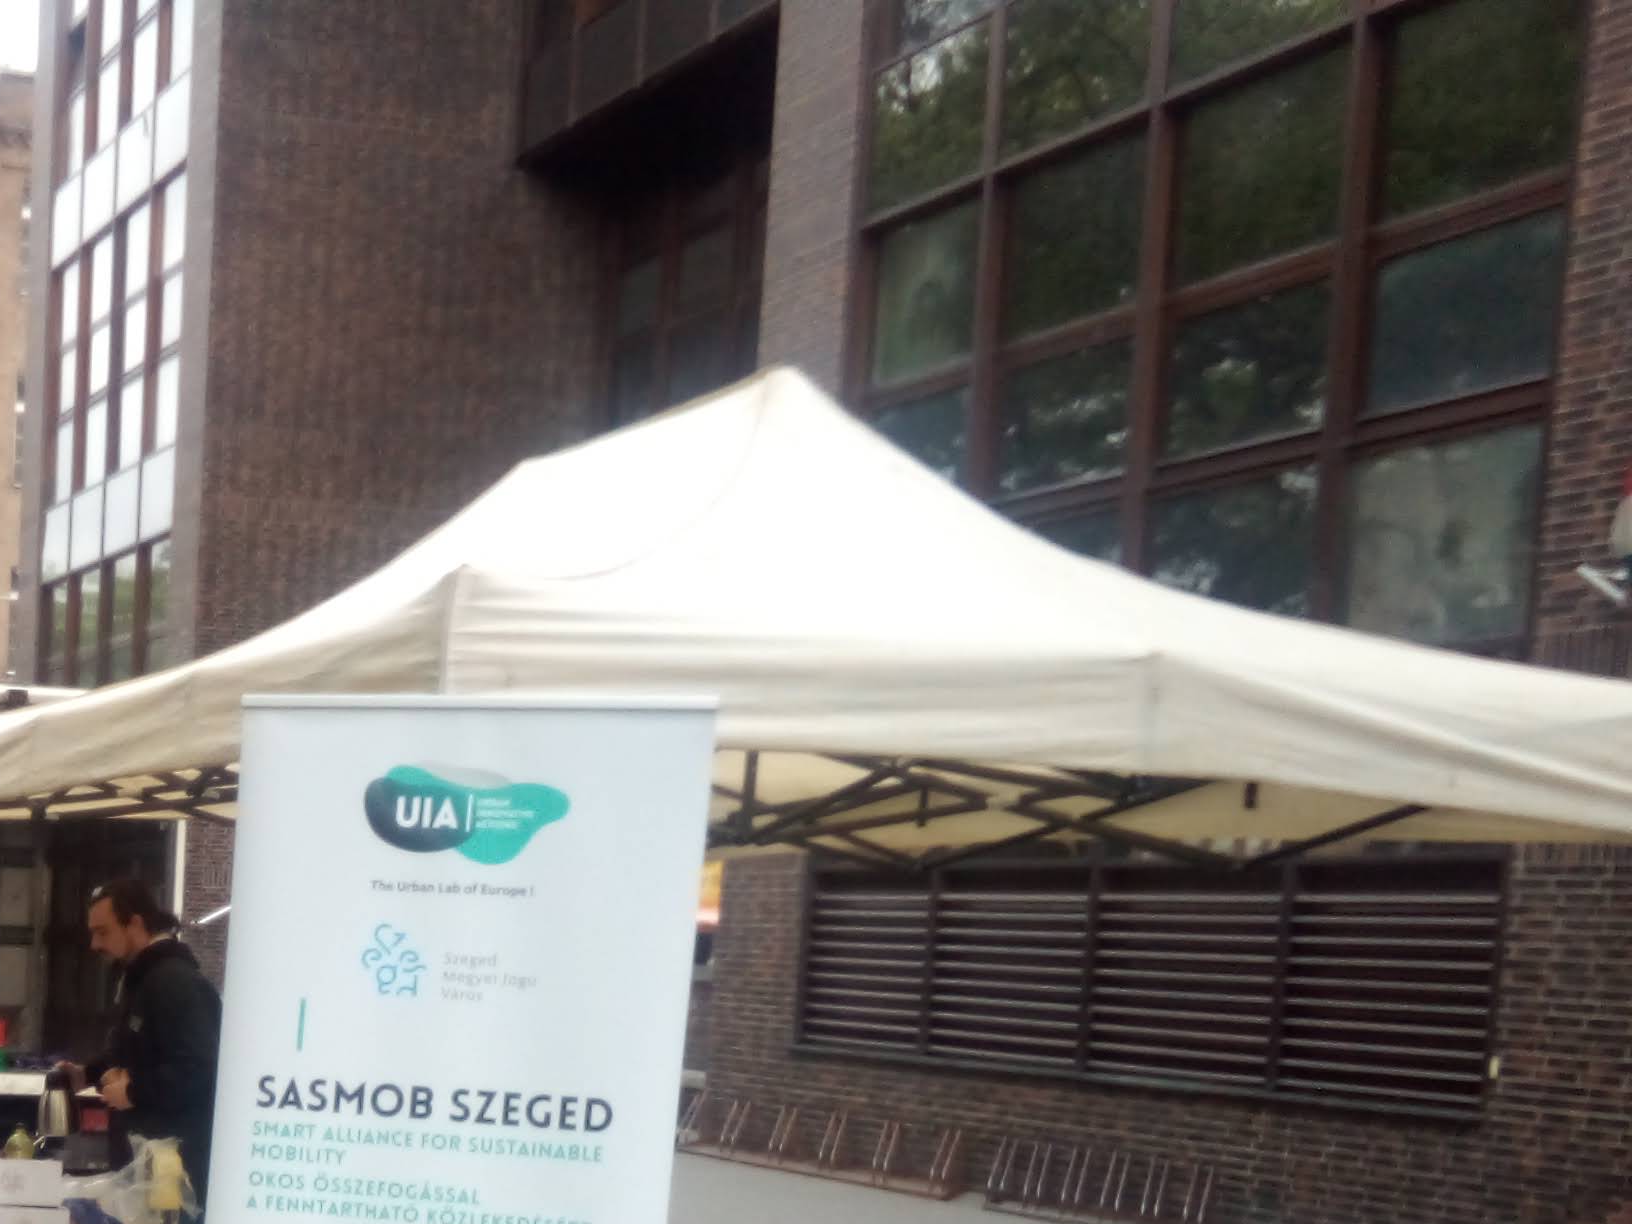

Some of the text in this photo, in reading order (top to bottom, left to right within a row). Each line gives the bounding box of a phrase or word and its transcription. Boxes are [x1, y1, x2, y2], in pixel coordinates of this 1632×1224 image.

[395, 795, 459, 829] UIA
[371, 879, 393, 892] The
[397, 881, 434, 893] Urban
[438, 881, 461, 894] Lab
[464, 882, 477, 895] of
[481, 883, 526, 897] Europe
[256, 1074, 614, 1132] SASMOB SZEGED
[250, 1142, 347, 1165] MOBILITY
[252, 1120, 604, 1163] SMART ALLIANCE FOR SUSTAINABLE
[248, 1171, 480, 1205] OKOS ÖSSZEFOGÁSSAL
